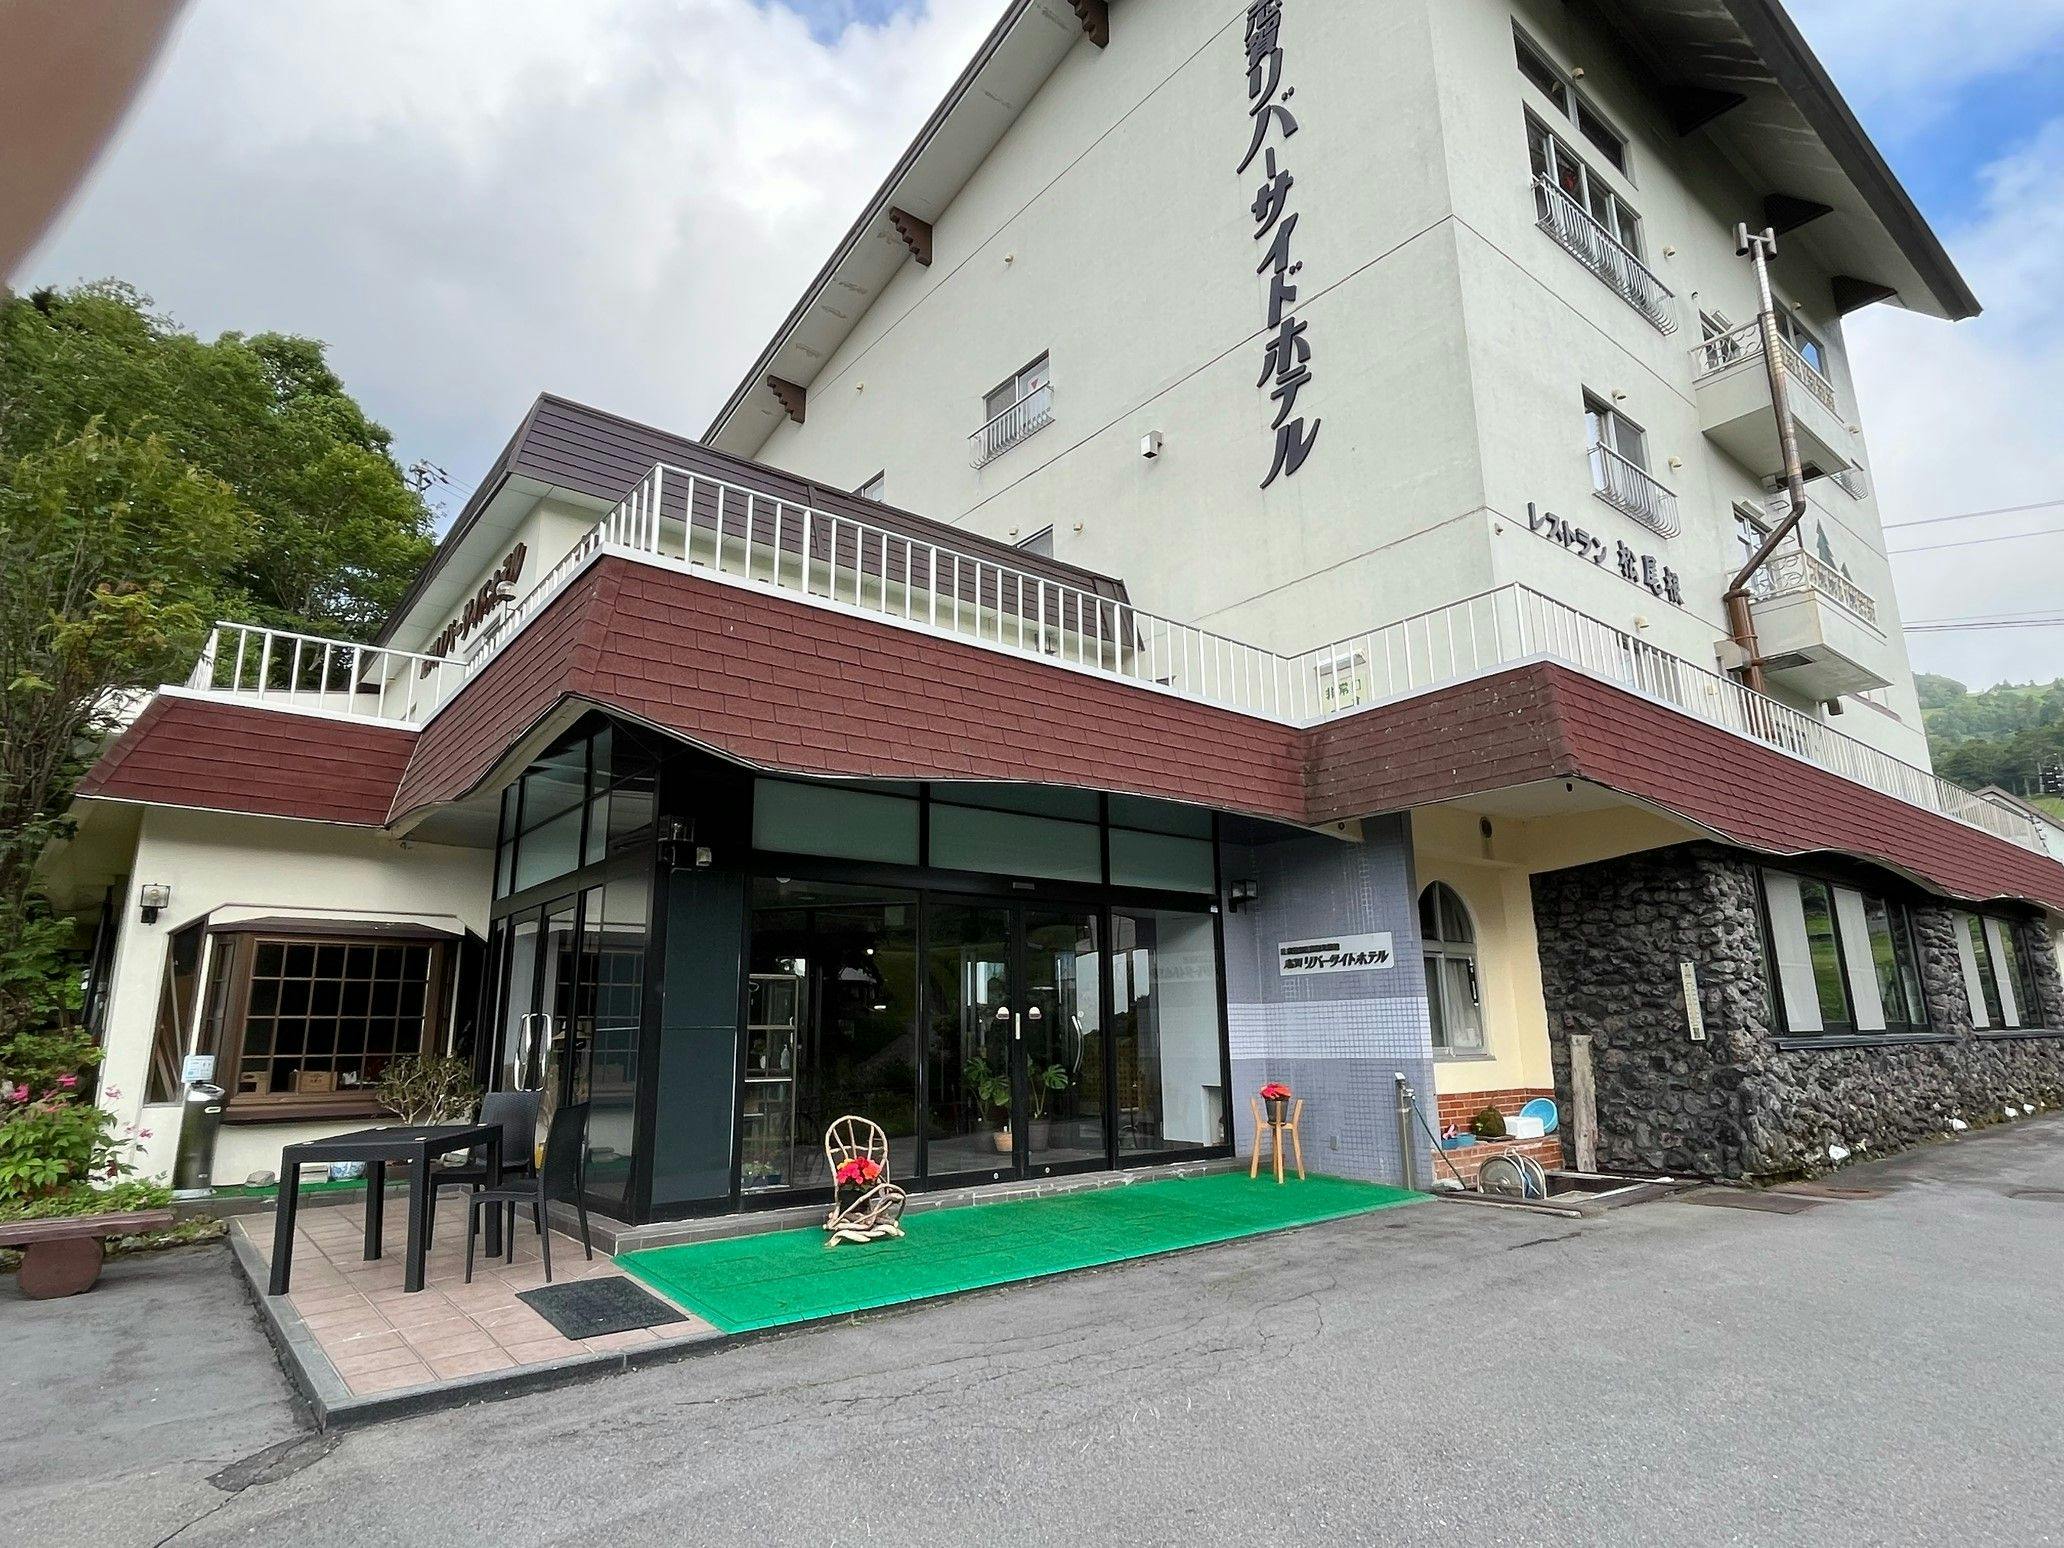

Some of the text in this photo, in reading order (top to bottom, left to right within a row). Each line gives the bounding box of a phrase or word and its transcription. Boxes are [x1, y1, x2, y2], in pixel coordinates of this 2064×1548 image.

[1528, 502, 1607, 564] レストラン
